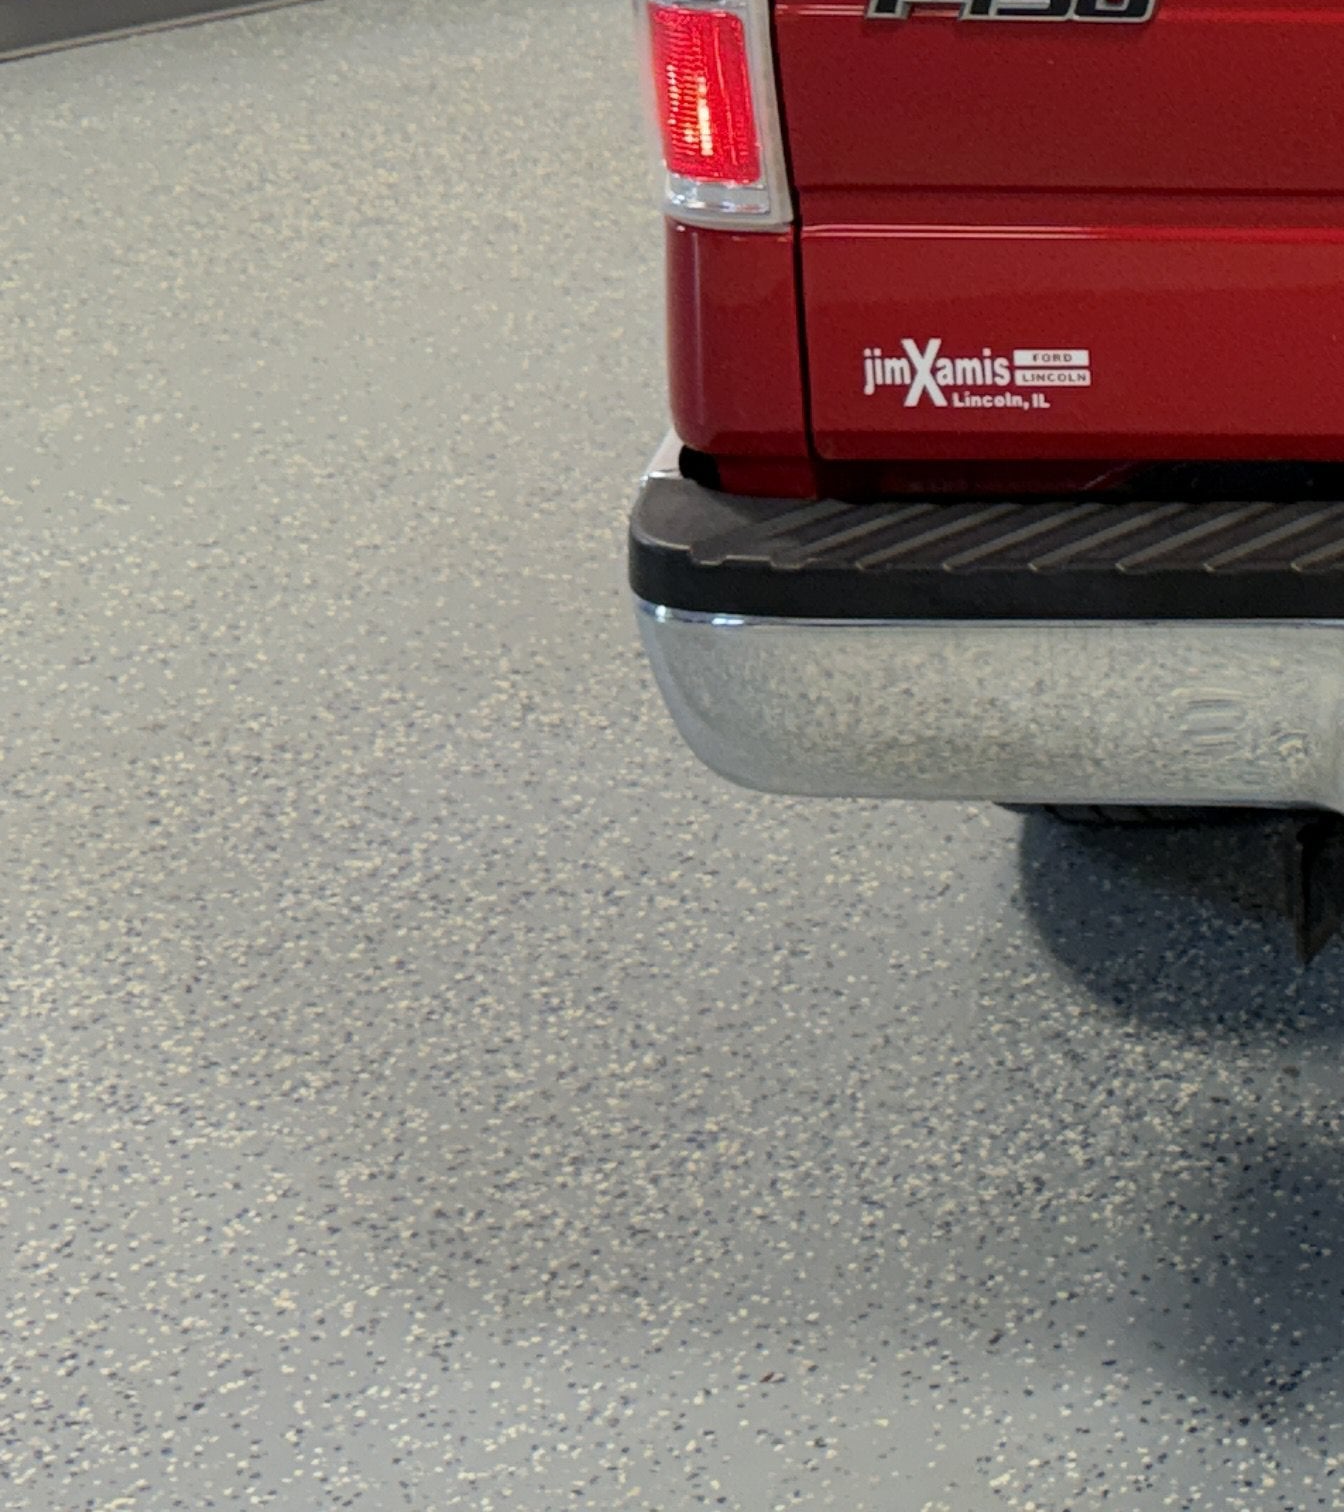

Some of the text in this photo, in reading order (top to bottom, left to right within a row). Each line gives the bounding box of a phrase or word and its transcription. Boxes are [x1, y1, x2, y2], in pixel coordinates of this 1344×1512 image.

[1033, 354, 1073, 363] FORD
[1022, 372, 1087, 383] LINCOLN
[952, 391, 1051, 410] Lincoln, IL
